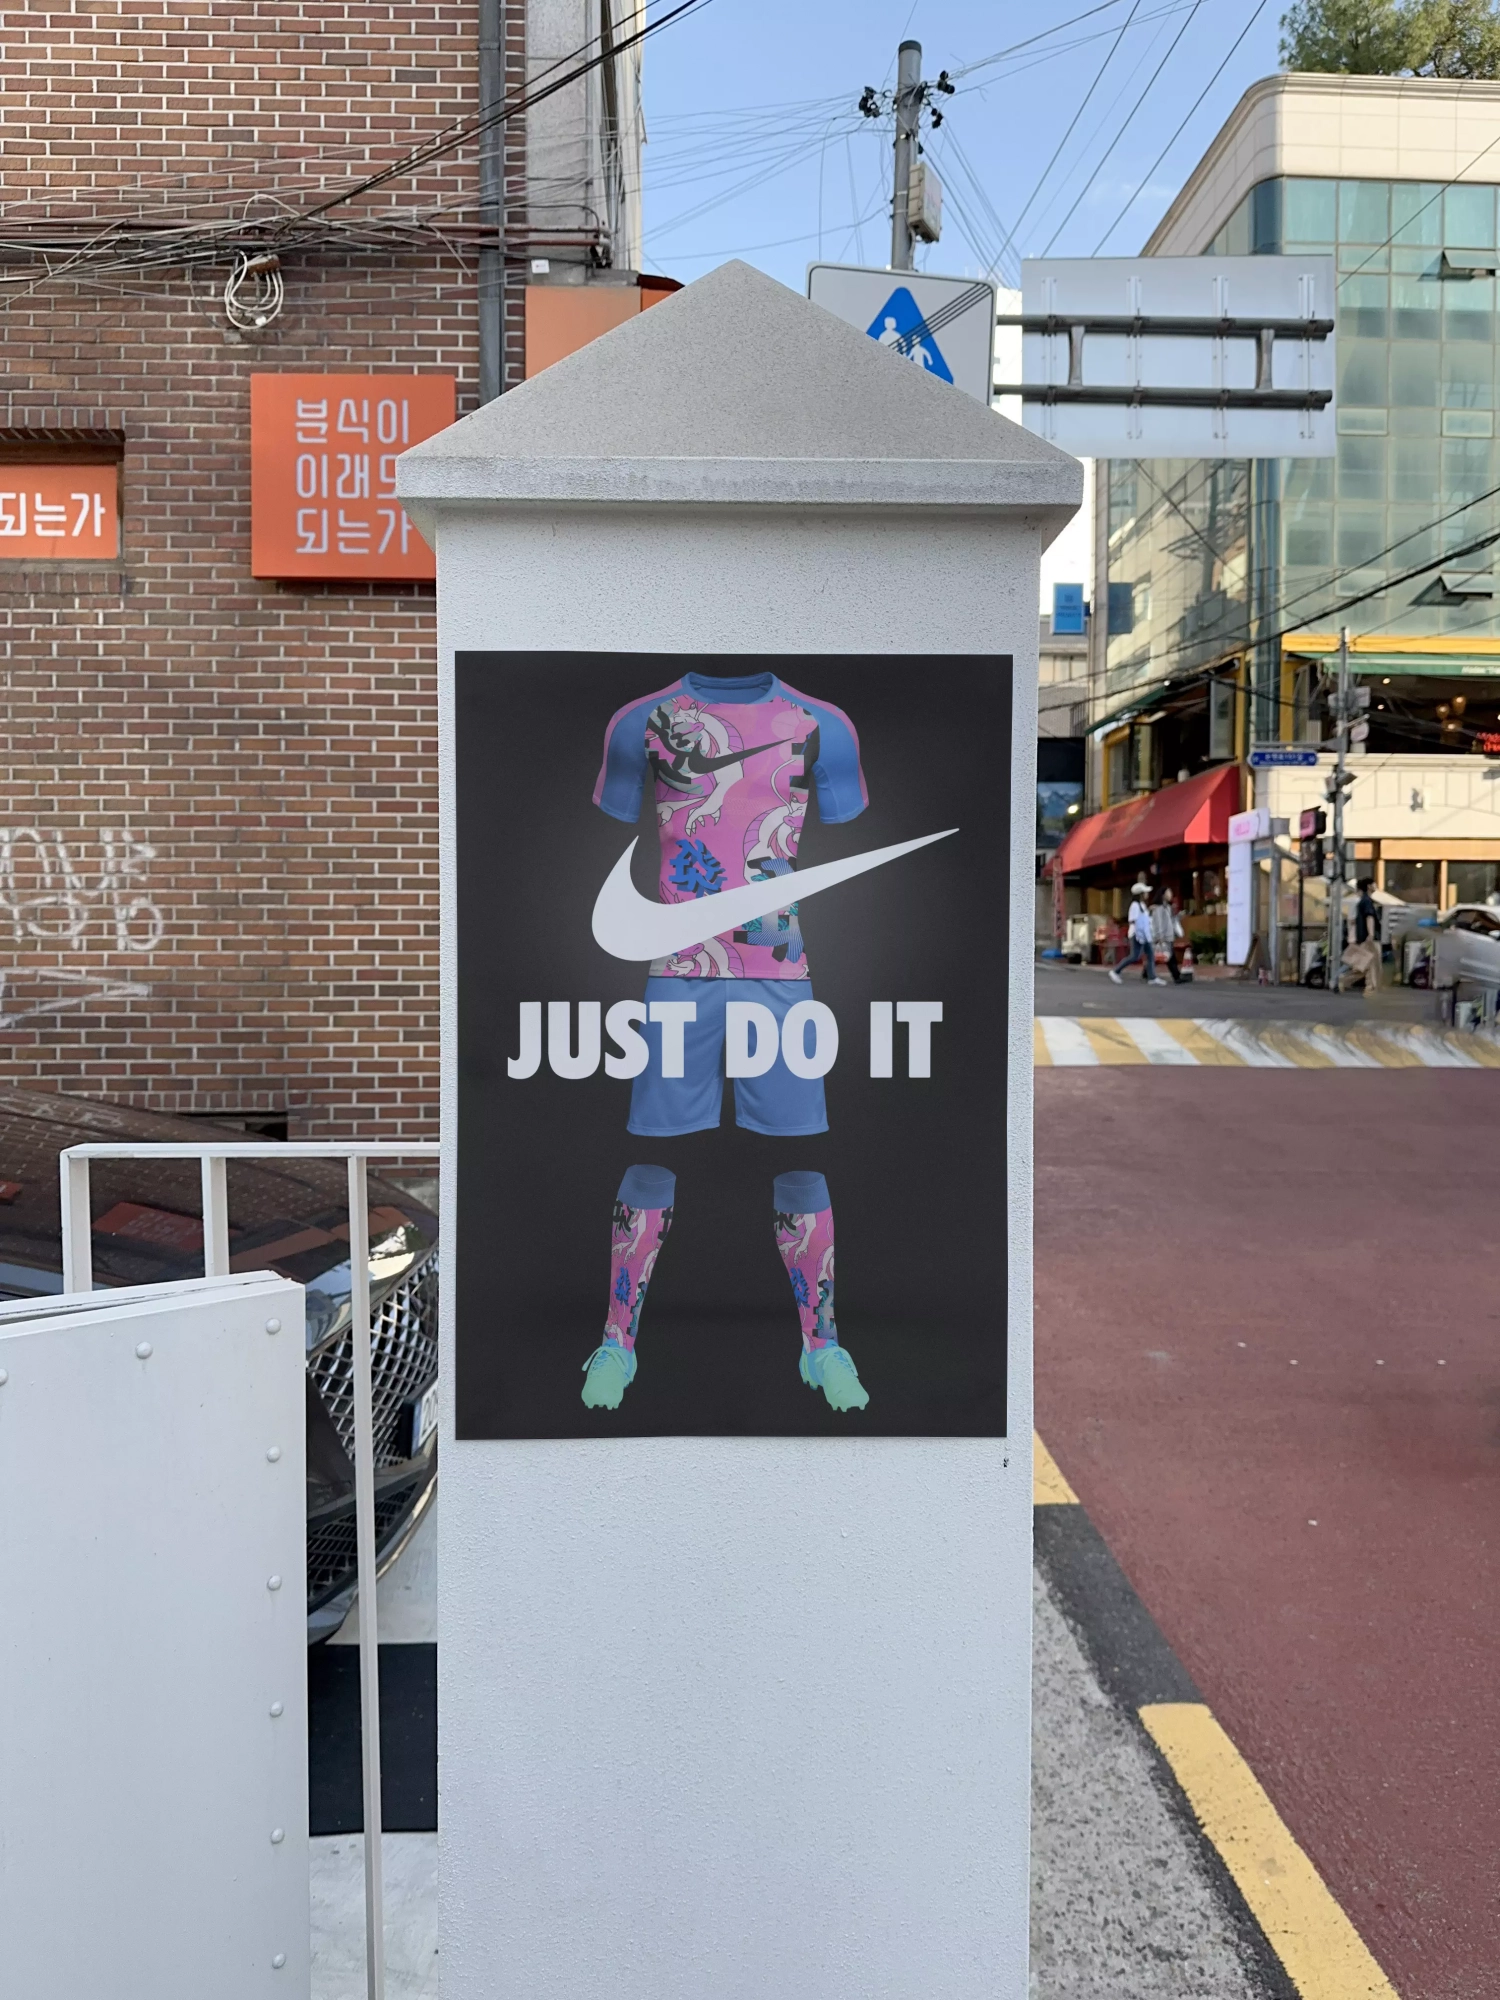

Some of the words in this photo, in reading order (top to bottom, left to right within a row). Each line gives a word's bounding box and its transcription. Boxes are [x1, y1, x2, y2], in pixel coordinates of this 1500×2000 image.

[296, 399, 409, 444] 분식이
[0, 492, 106, 537] 되는가
[296, 508, 413, 554] 되는가
[507, 1000, 697, 1080] JUST
[725, 1000, 839, 1079] DO
[870, 1001, 943, 1078] IT
